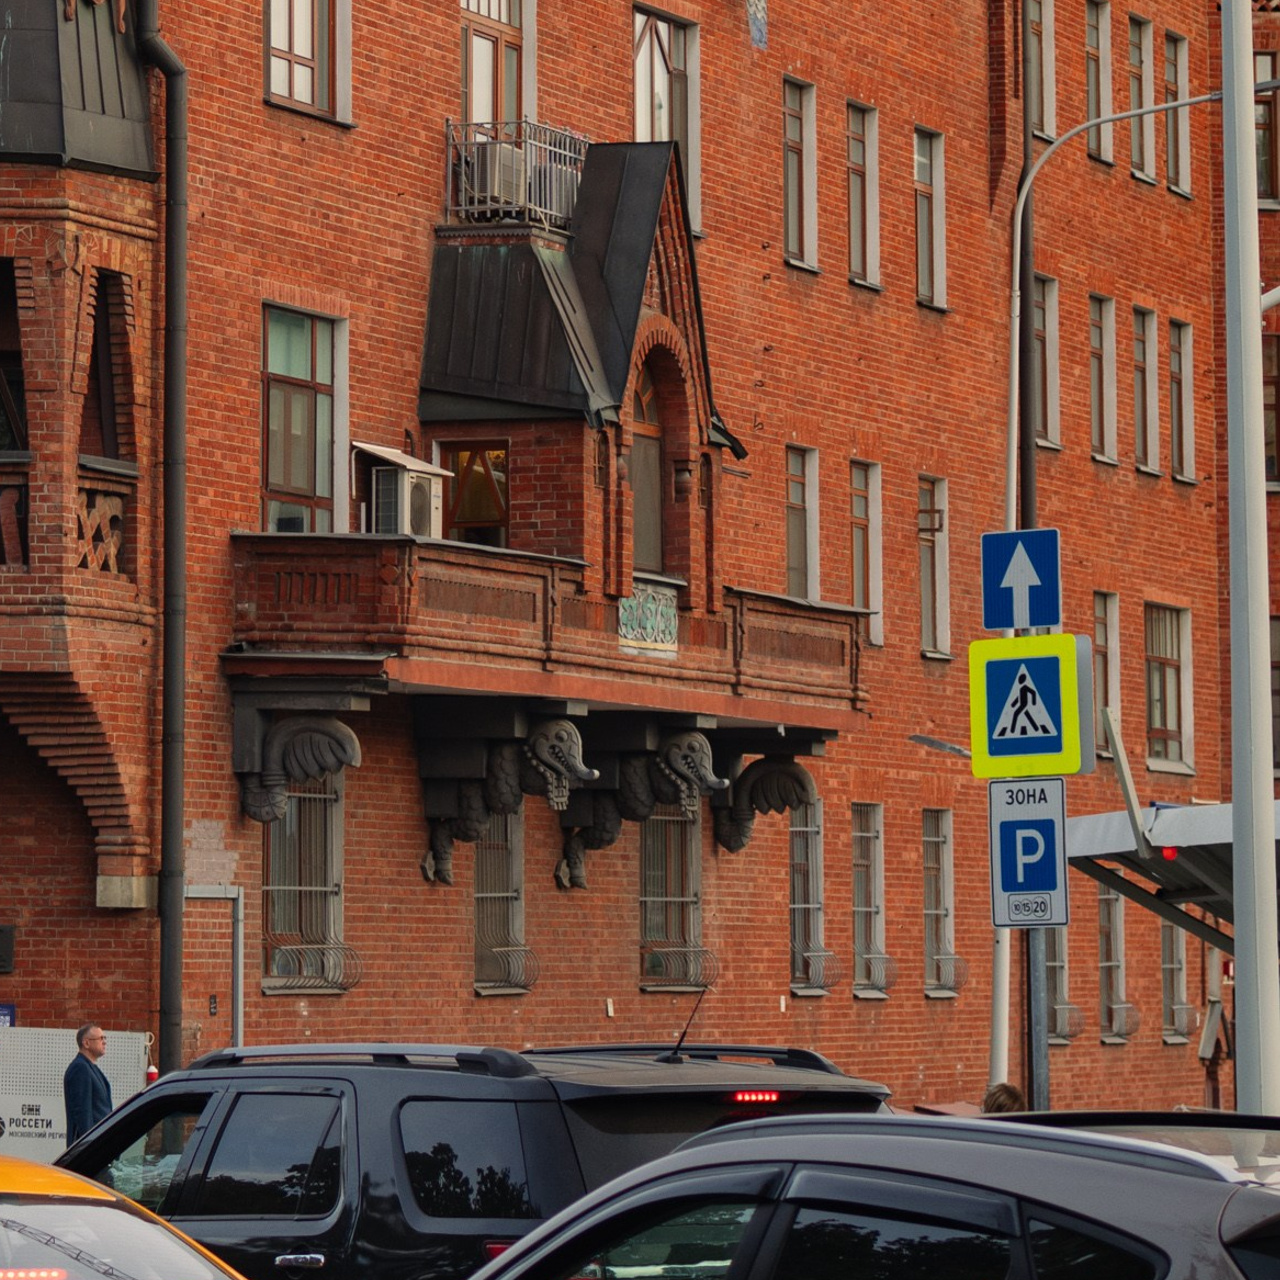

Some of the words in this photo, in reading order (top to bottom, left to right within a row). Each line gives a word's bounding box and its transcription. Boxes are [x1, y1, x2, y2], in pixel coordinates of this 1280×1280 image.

[1005, 787, 1048, 805] ЗОНА
[1014, 903, 1020, 912] 10
[1022, 902, 1031, 912] 15
[1033, 901, 1047, 912] 20
[9, 1117, 52, 1129] РОССЕТИ
